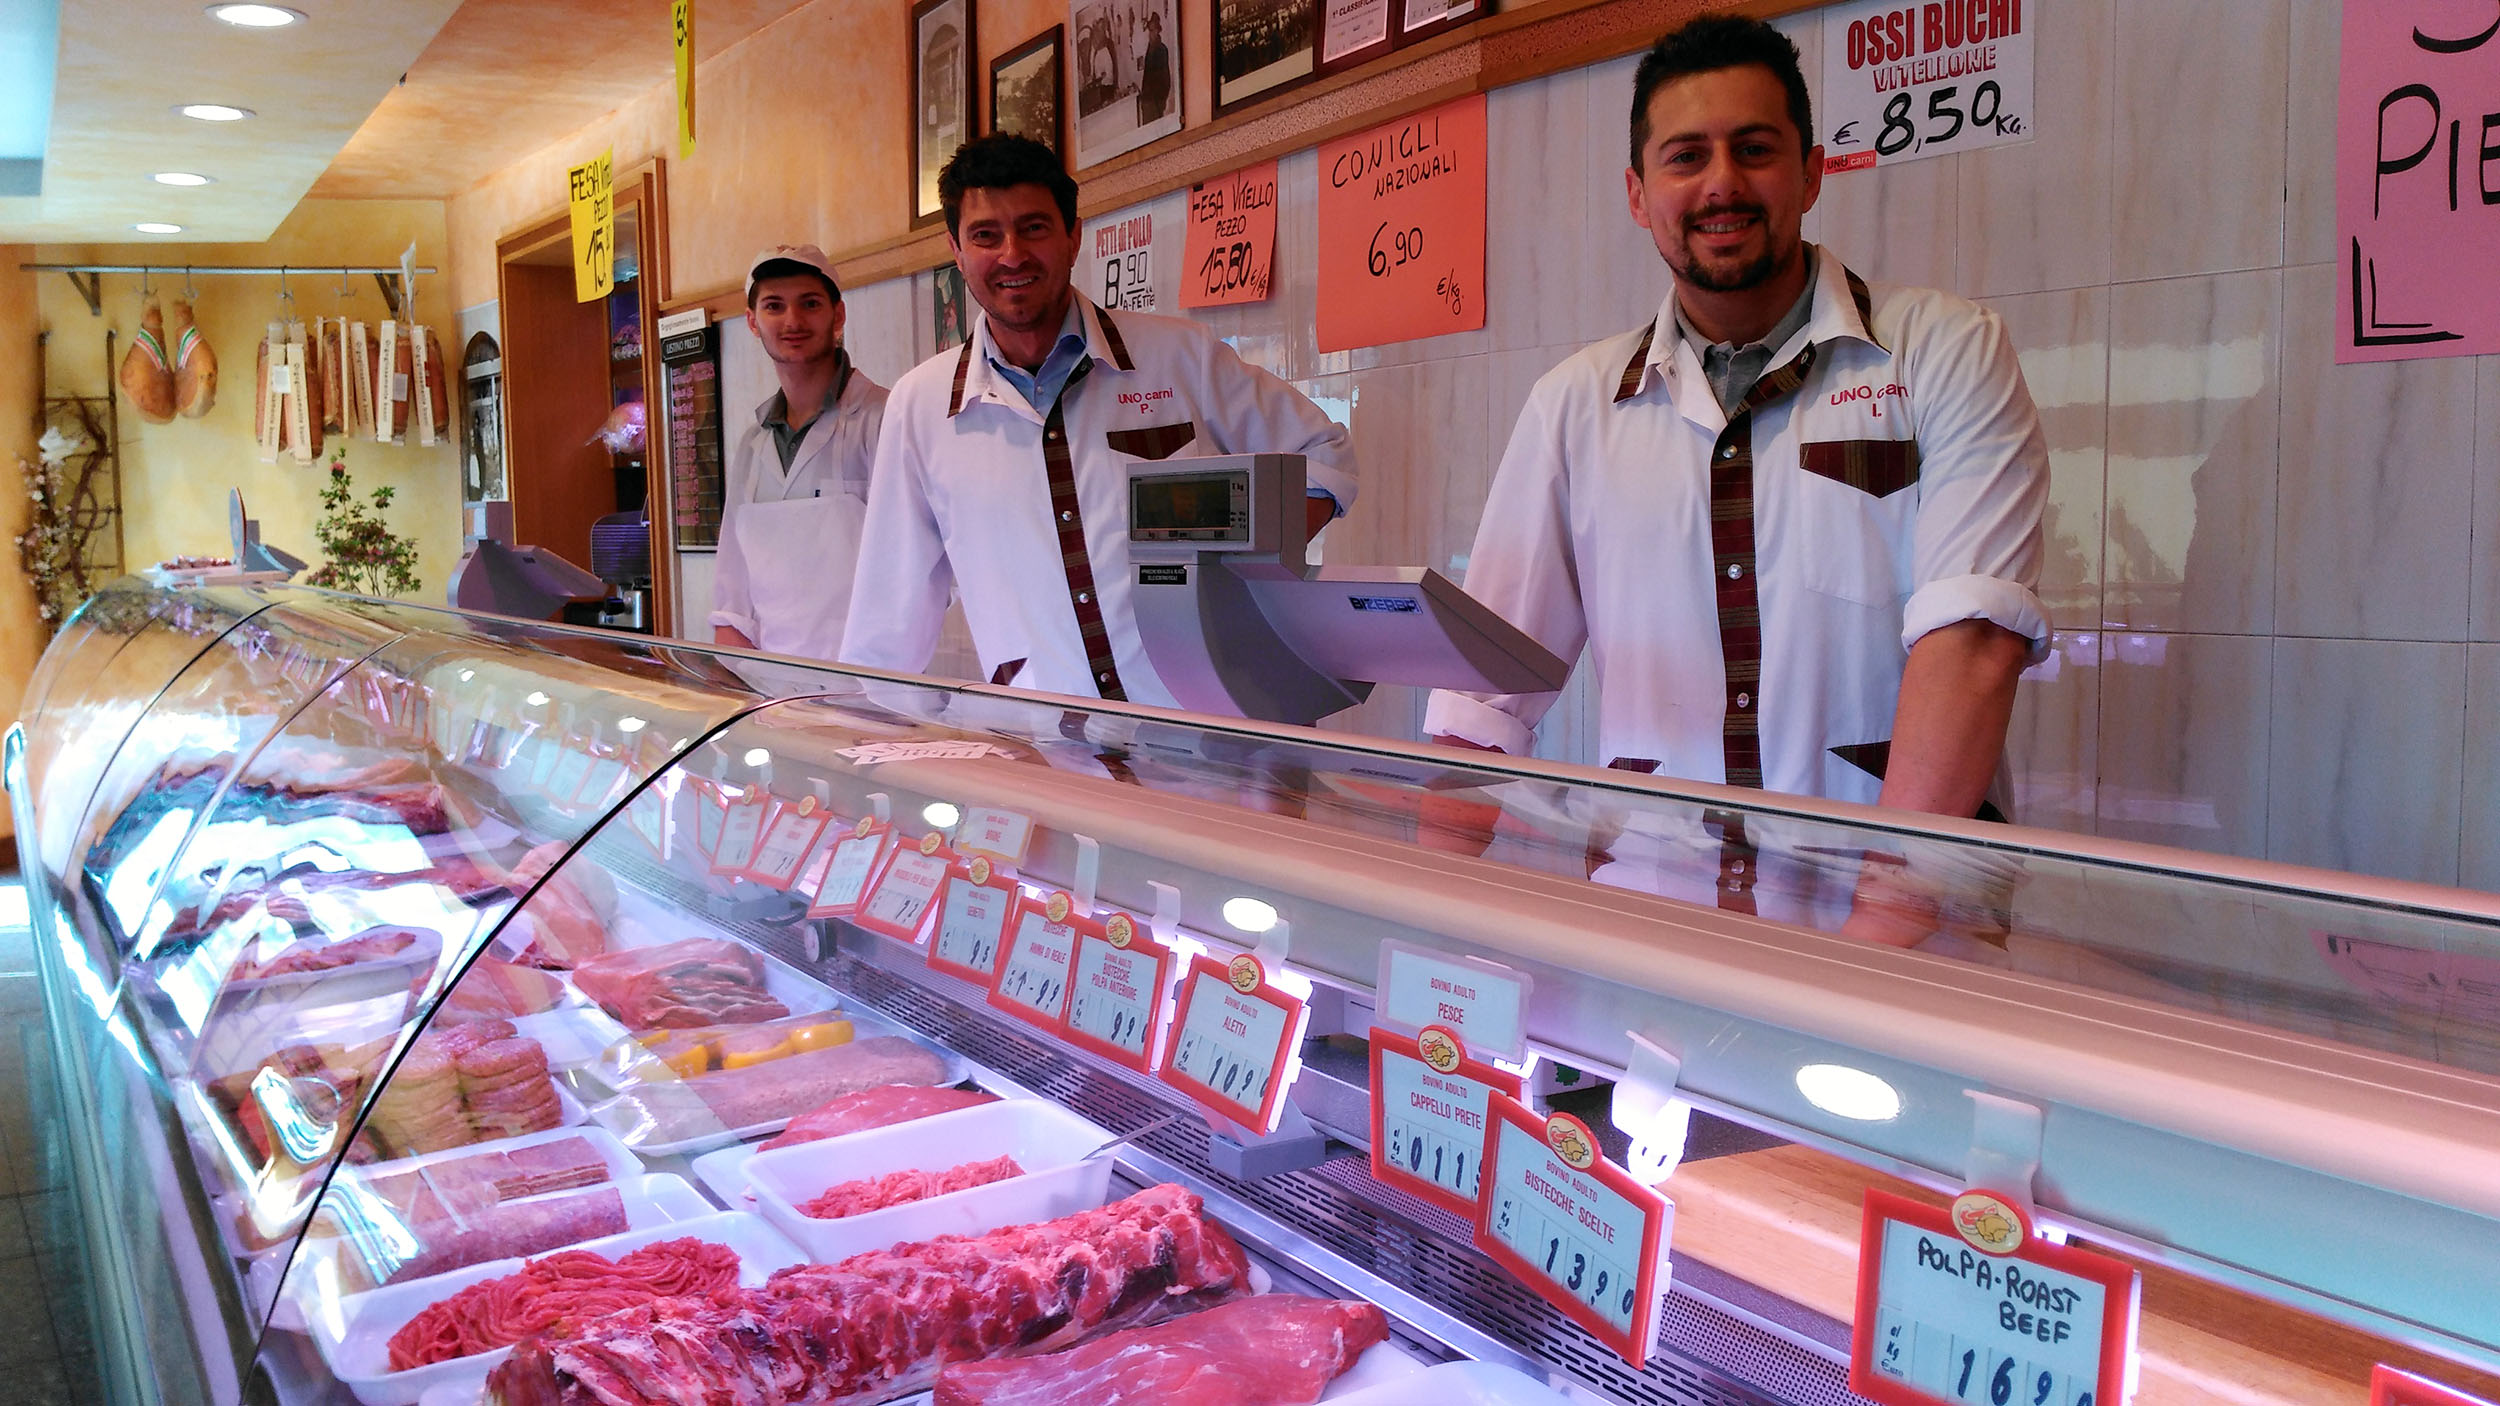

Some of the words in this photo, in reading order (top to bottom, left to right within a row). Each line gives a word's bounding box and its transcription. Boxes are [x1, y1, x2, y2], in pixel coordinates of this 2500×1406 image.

[1847, 8, 1915, 70] OSSI
[1923, 0, 2022, 54] BUCHI
[1873, 45, 1996, 93] VITELLONE
[1832, 121, 1860, 145] €
[1875, 80, 2001, 156] 8,50
[1332, 116, 1438, 188] CONIGLI
[570, 161, 599, 202] FESA
[1374, 150, 1456, 200] NAZIONALI
[1192, 184, 1224, 224] FESA
[1096, 224, 1116, 259] PETTI
[1118, 222, 1126, 253] di
[1128, 213, 1152, 250] POLLO
[1215, 215, 1246, 239] PEZZO
[1200, 241, 1252, 298] 15,80
[1368, 221, 1423, 277] 6,90
[1118, 392, 1142, 404] UNO
[1145, 387, 1173, 400] carni
[1140, 403, 1153, 414] P.
[1831, 386, 1872, 406] UNO
[1431, 977, 1451, 993] BOVINO
[1453, 984, 1475, 1000] ADULTO
[1222, 1015, 1247, 1038] ALETTA
[1438, 1001, 1464, 1025] PESCE
[1422, 1074, 1443, 1090] BOVINO
[1445, 1082, 1467, 1098] ADULTO
[1411, 1091, 1451, 1119] CAPPELLO
[1455, 1106, 1482, 1130] PRETE
[1546, 1160, 1570, 1184] BOVINO
[1572, 1177, 1598, 1203] ADULTO
[1524, 1169, 1575, 1216] BISTECCHE
[1578, 1206, 1615, 1244] SCELTE
[1999, 1300, 2072, 1344] BEEF
